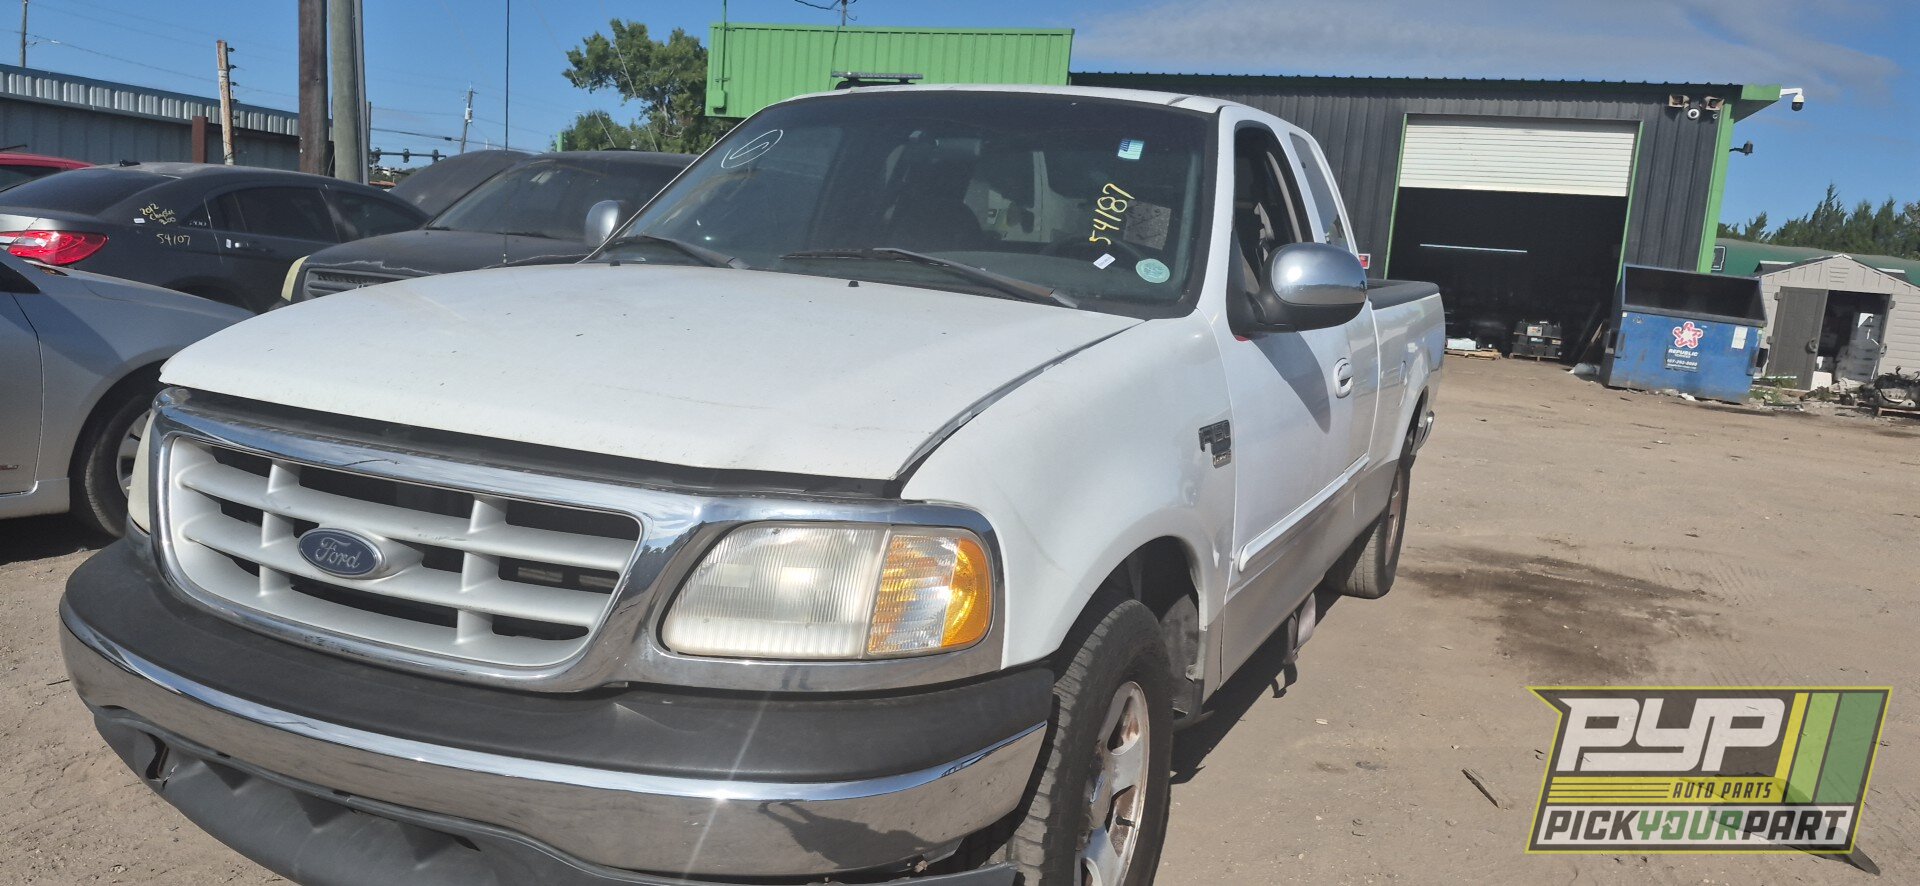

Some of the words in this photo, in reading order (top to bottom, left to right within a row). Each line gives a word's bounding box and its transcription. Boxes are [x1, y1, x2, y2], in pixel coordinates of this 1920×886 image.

[139, 203, 159, 216] 2012
[1088, 183, 1135, 246] 54187
[156, 233, 191, 246] 54107
[1668, 348, 1699, 357] REPUBLIC
[315, 536, 362, 569] Ford
